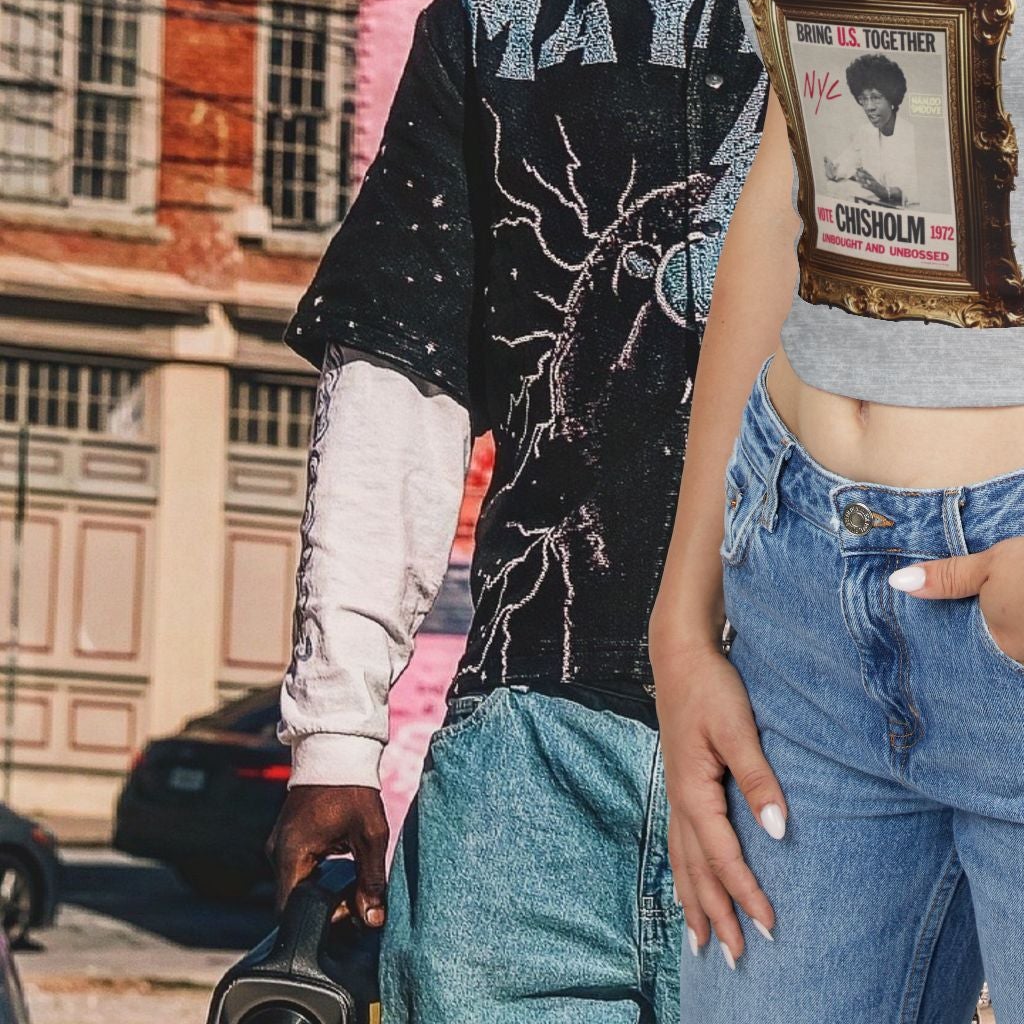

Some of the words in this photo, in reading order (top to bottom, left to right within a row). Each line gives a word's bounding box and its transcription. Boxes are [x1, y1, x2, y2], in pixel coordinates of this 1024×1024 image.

[795, 22, 833, 45] BRING
[836, 26, 861, 47] U.S.
[863, 28, 936, 53] TOGETHER
[803, 70, 842, 115] NYC
[817, 206, 834, 224] VOTE
[835, 203, 926, 245] CHISHOLM
[930, 225, 955, 241] 1972
[822, 233, 863, 250] UNBOUGHT
[865, 242, 885, 254] AND
[889, 246, 949, 262] UNBOSSED
